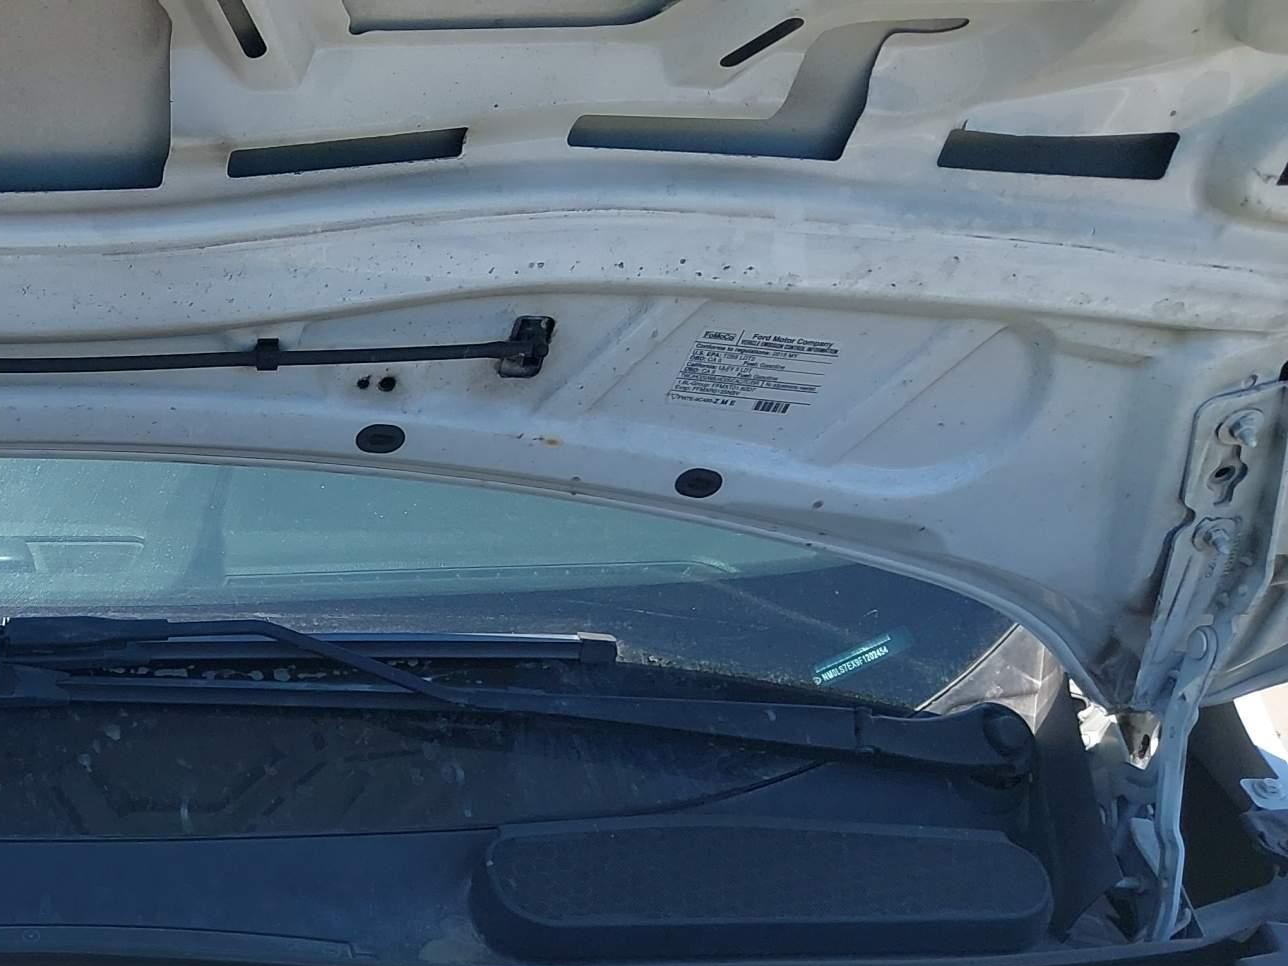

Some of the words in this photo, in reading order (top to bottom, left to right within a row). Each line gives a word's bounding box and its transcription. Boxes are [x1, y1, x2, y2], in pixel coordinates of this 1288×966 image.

[703, 331, 737, 341] FoMoCo
[752, 333, 772, 341] Ford
[772, 336, 795, 344] Motor
[796, 338, 834, 350] Company
